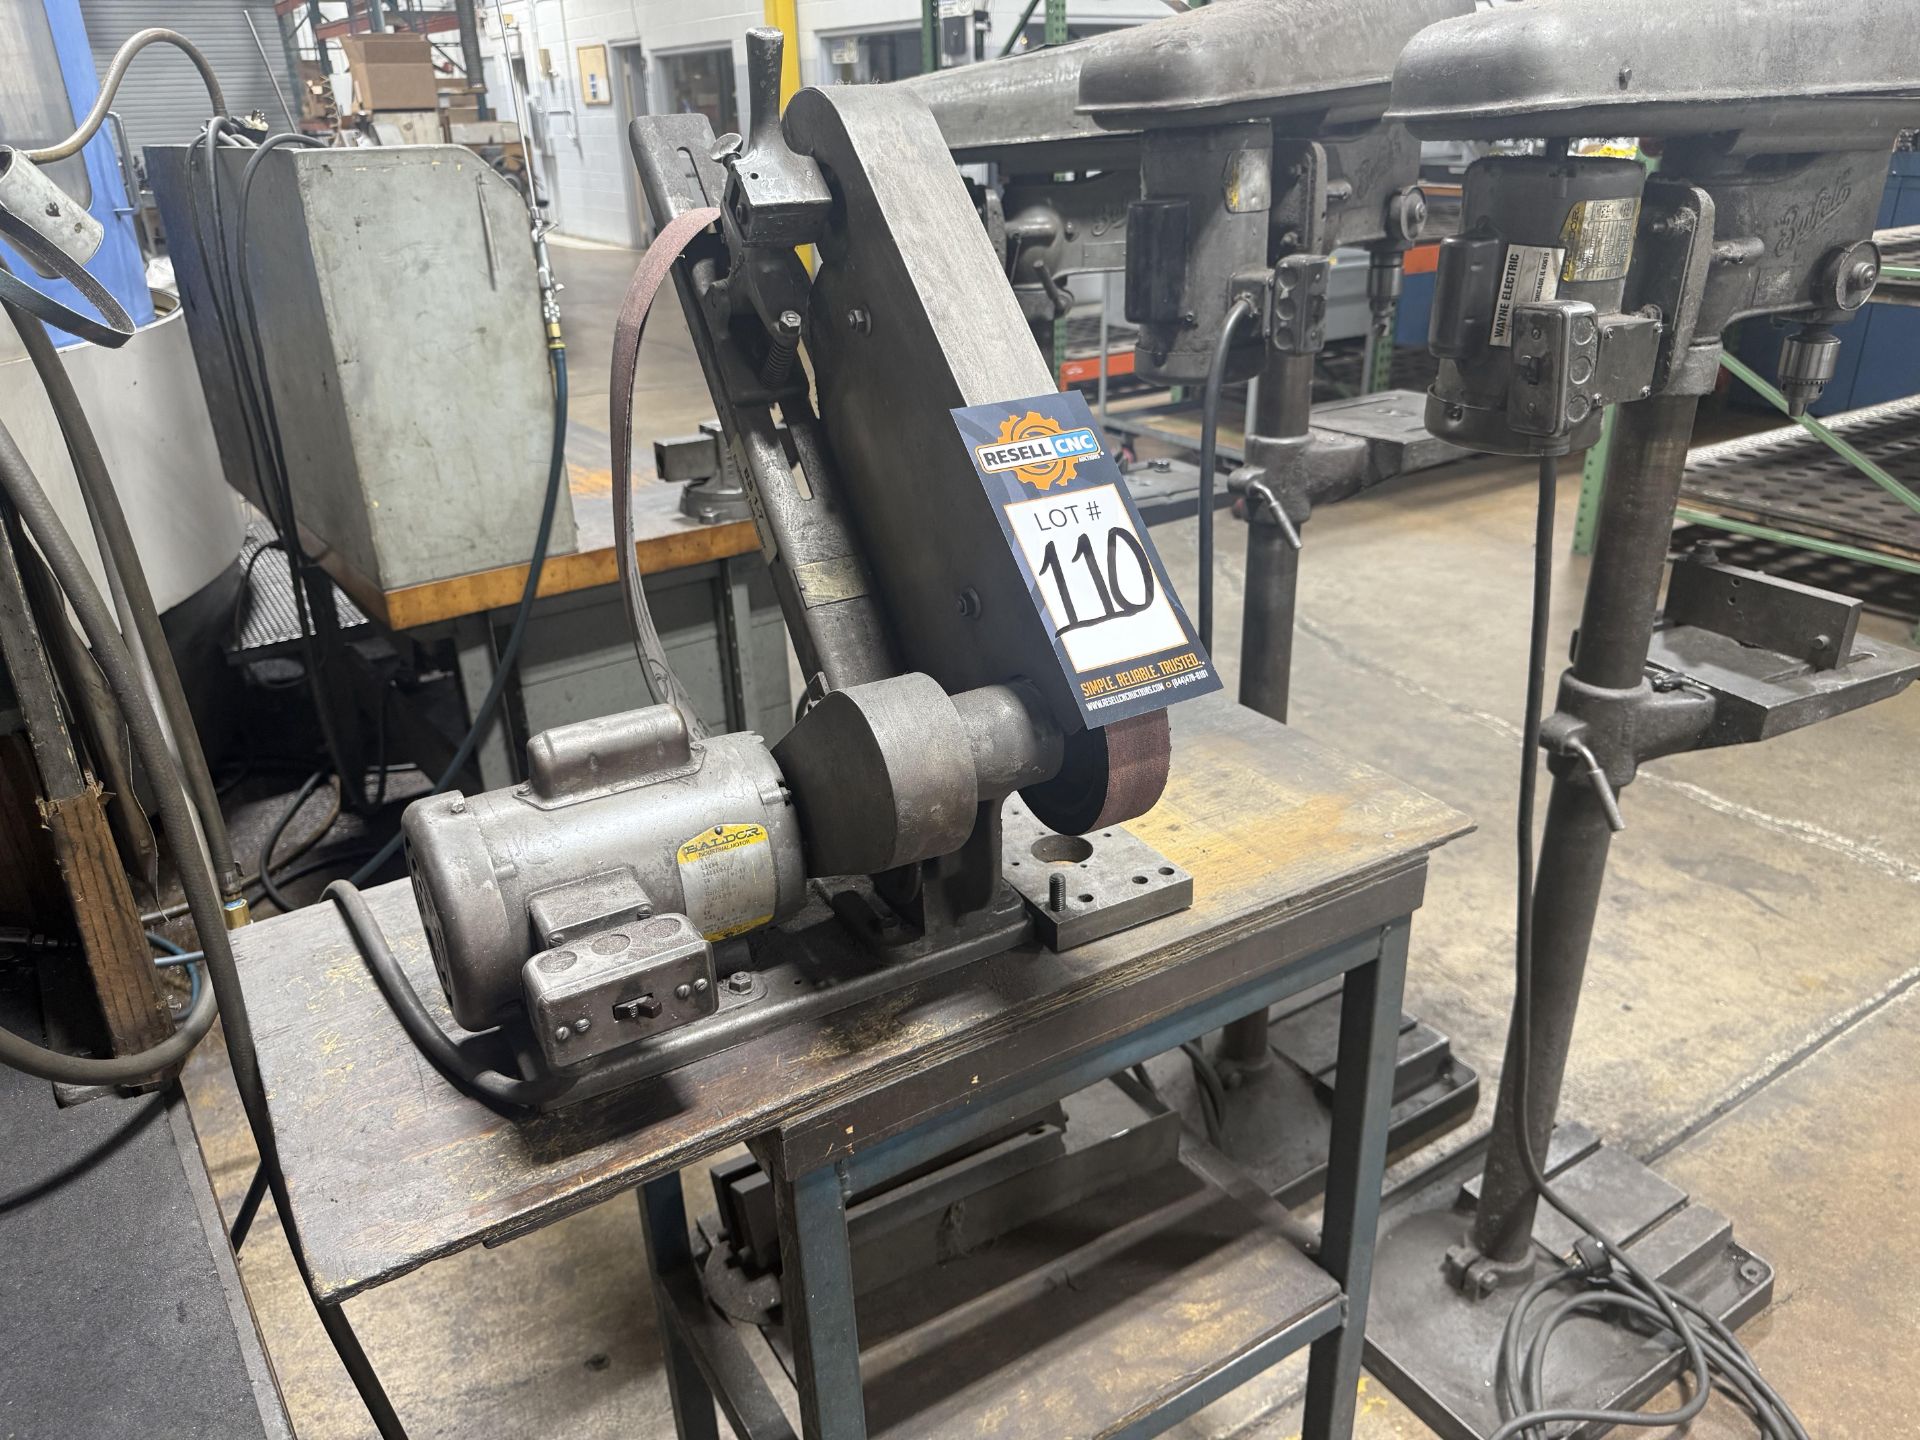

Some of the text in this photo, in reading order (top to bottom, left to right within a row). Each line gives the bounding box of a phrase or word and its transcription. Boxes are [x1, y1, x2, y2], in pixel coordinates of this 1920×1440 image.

[1494, 253, 1520, 338] WAYNE ELECTRIC
[983, 434, 1094, 466] RESELL CNC
[1034, 501, 1102, 532] LOT #
[1039, 526, 1155, 629] 110
[1080, 652, 1202, 697] SIMPLE. RELIABLE. TRUSTED.
[684, 827, 761, 854] BALDOR
